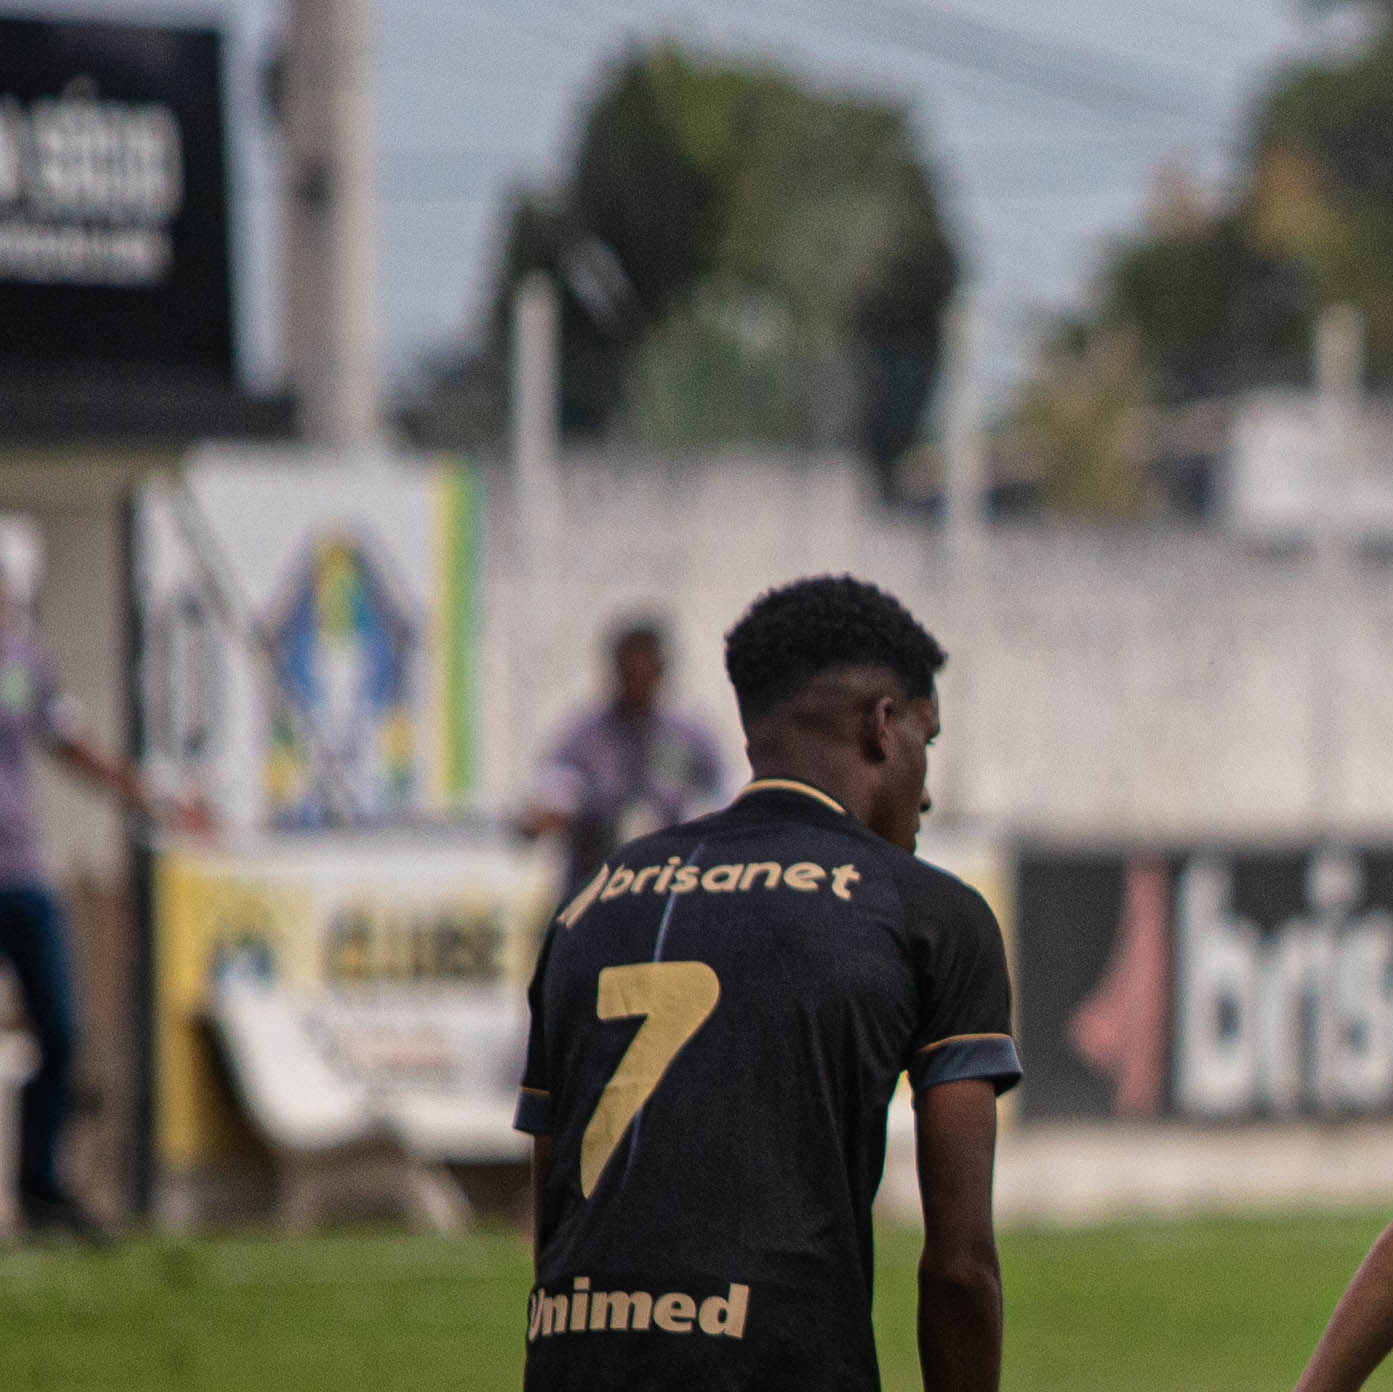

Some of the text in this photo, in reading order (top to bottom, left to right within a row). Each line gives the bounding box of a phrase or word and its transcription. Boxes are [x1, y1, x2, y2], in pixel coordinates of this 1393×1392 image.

[600, 856, 861, 901] brisanet
[581, 961, 721, 1198] 7
[528, 1276, 750, 1343] Unimed
